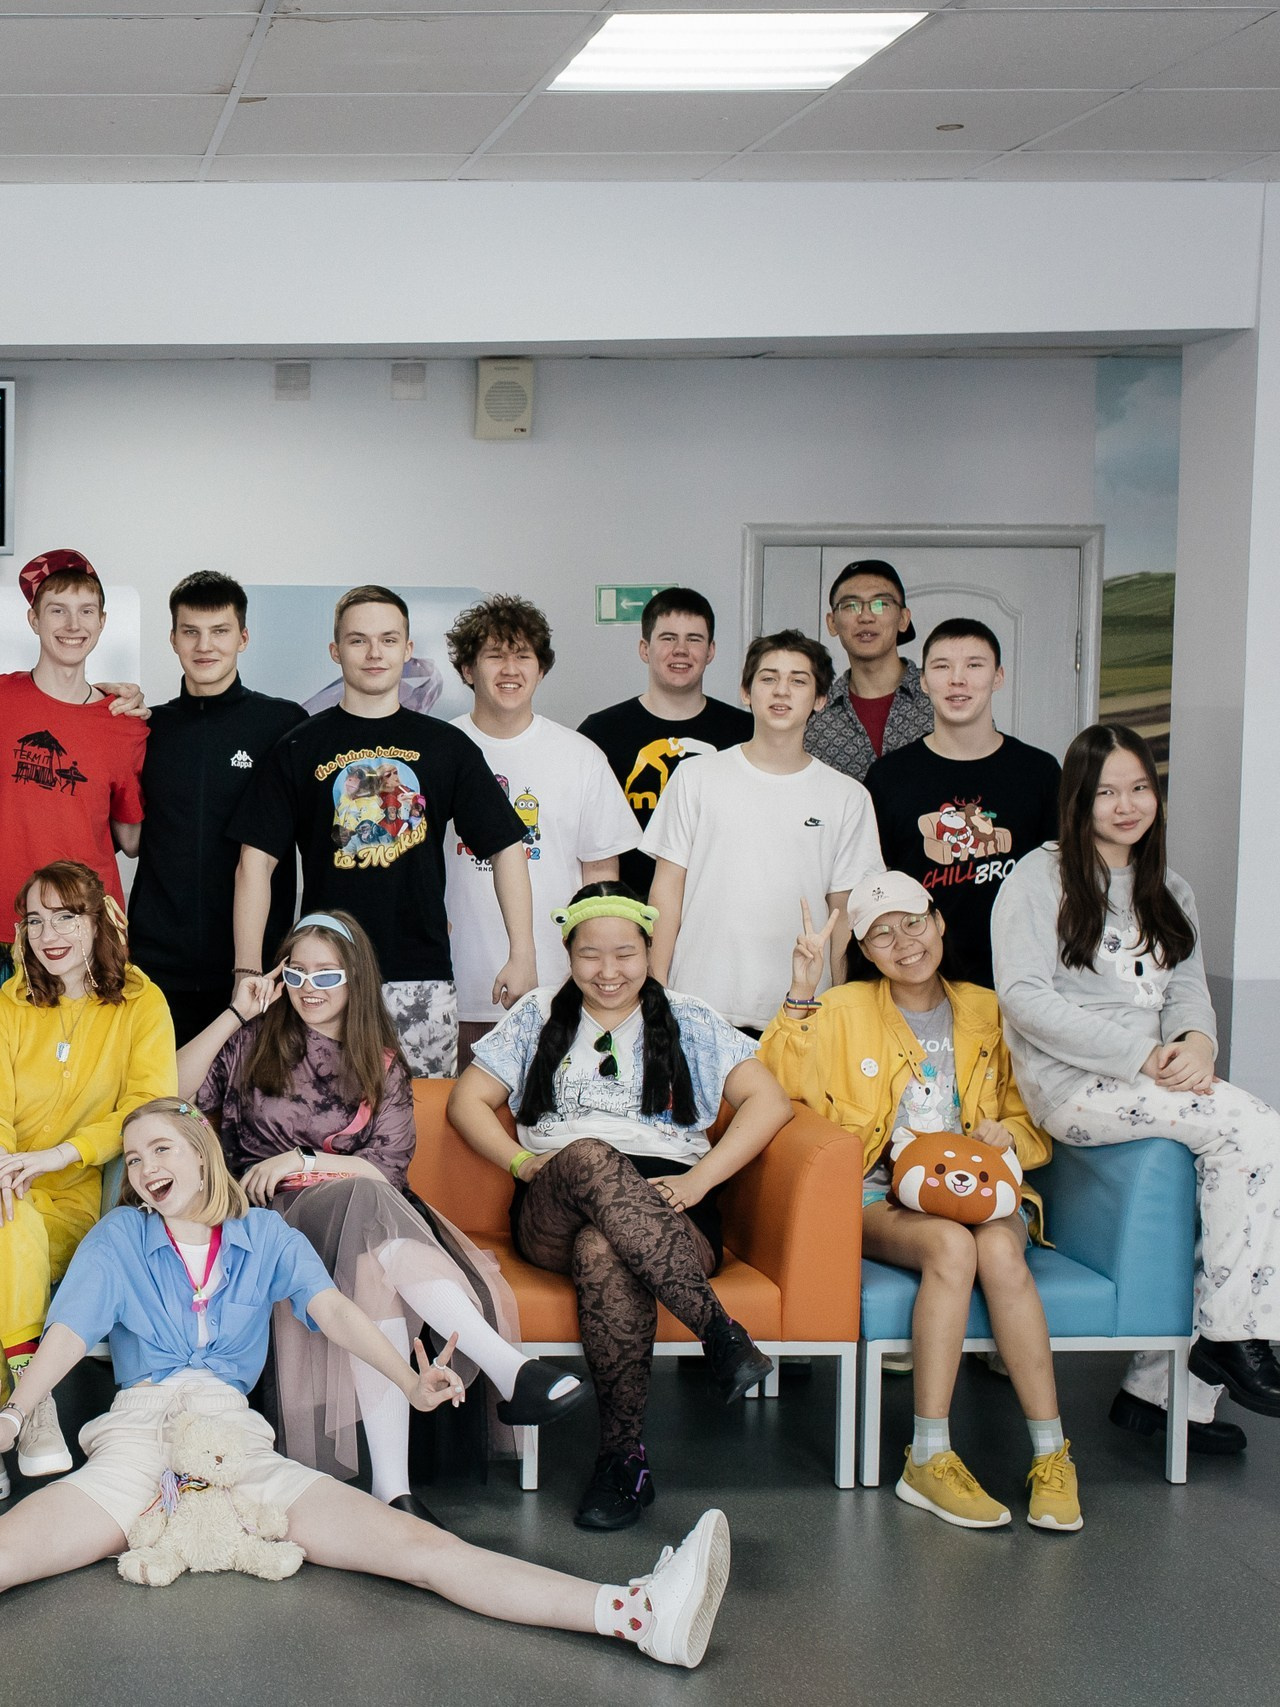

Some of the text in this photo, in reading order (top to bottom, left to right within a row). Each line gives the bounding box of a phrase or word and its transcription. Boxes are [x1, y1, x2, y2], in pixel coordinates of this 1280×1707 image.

[231, 758, 253, 769] Kappa
[315, 745, 421, 781] the future belongs
[334, 848, 356, 869] to
[922, 861, 980, 889] CHILL
